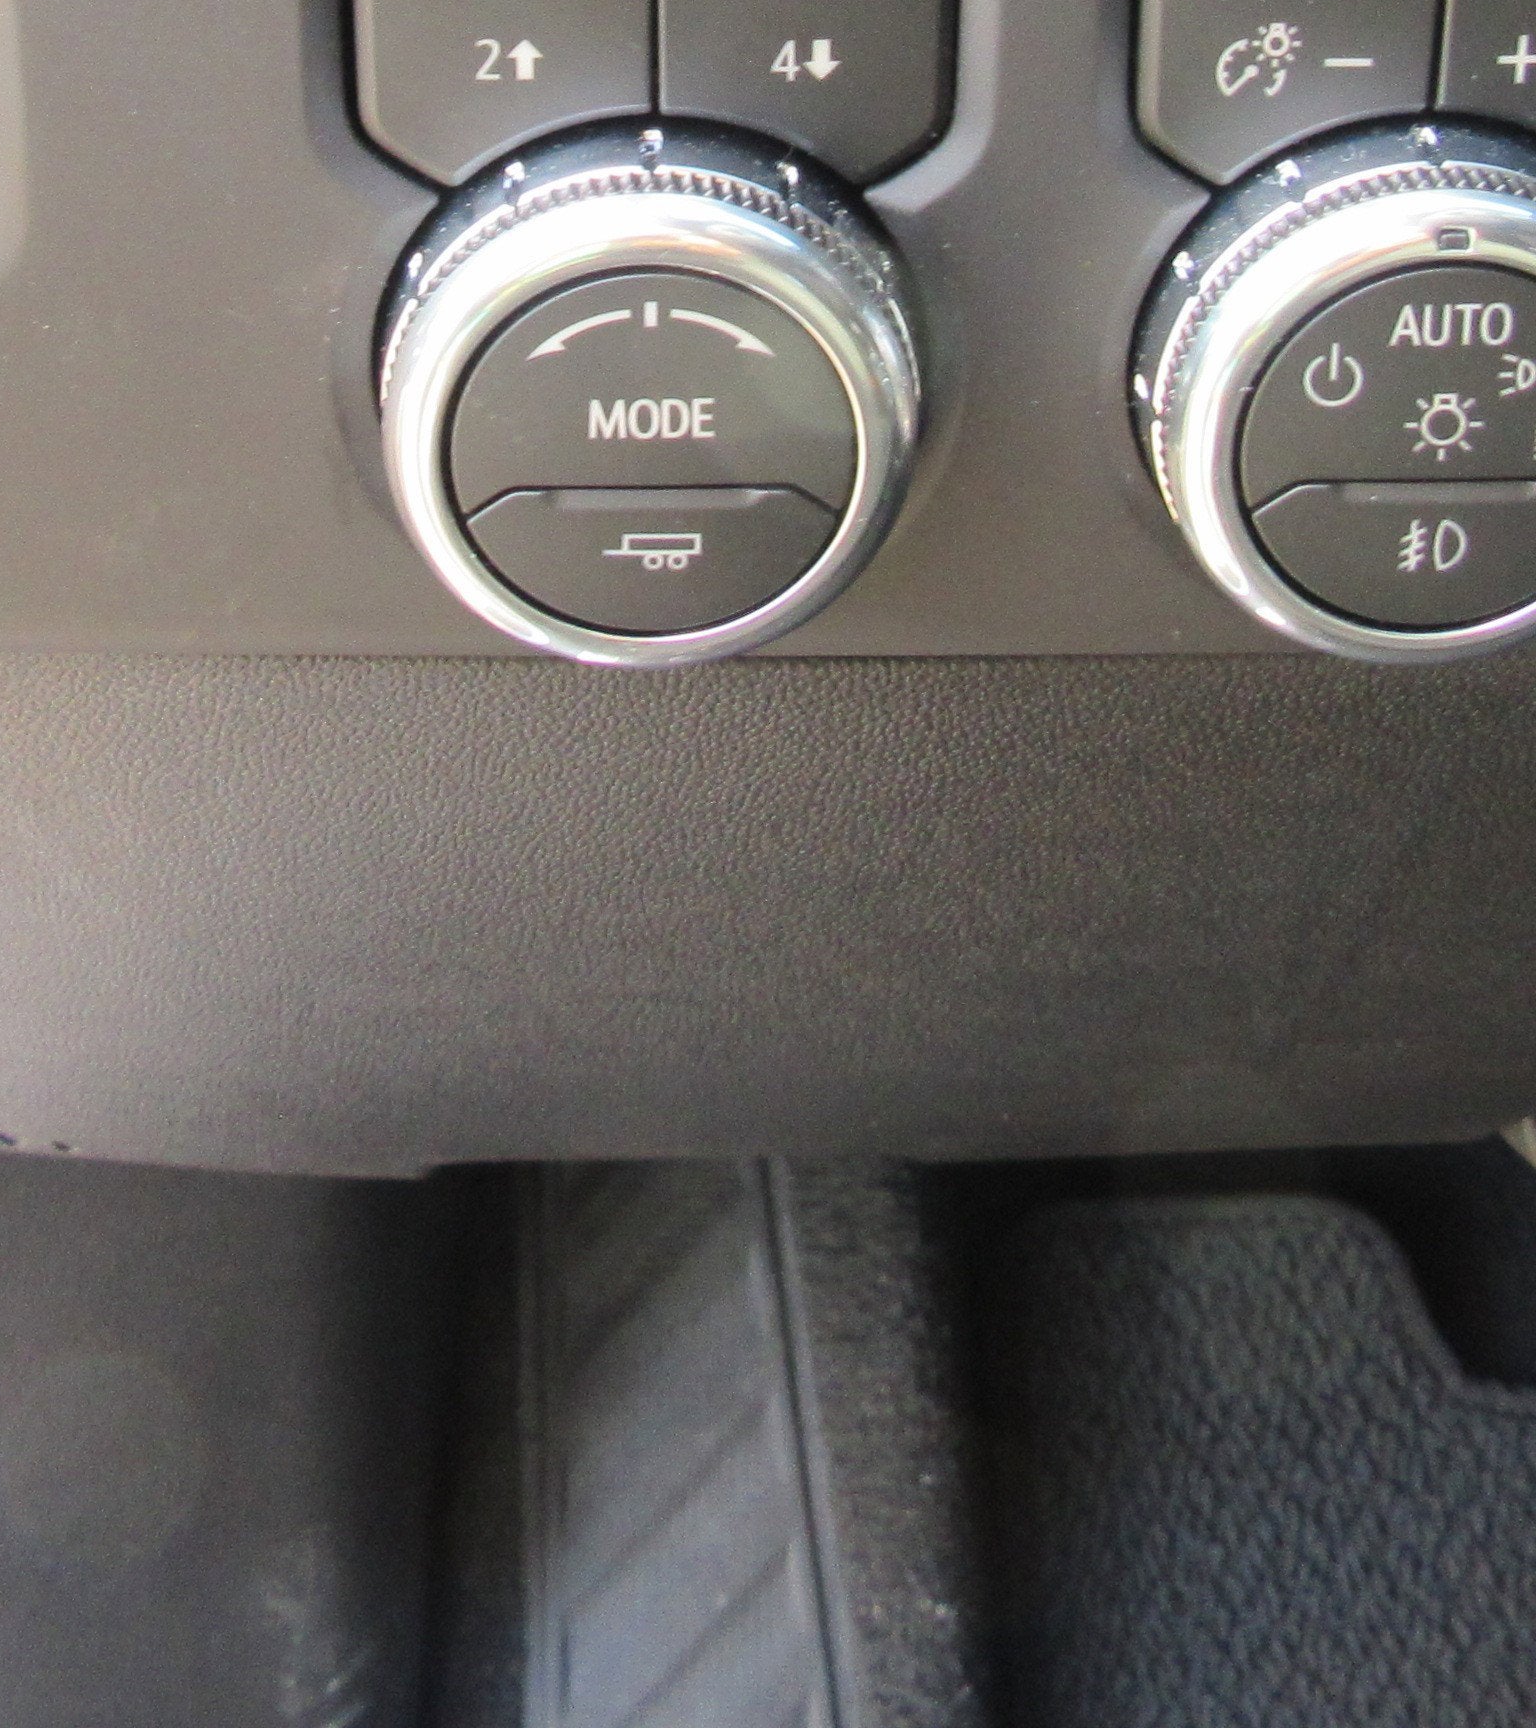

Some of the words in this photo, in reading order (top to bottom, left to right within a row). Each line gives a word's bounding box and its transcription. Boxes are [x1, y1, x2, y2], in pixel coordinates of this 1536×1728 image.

[474, 38, 502, 83] 2
[770, 39, 801, 83] 4
[1388, 302, 1515, 348] AUTO
[587, 396, 716, 441] MODE
